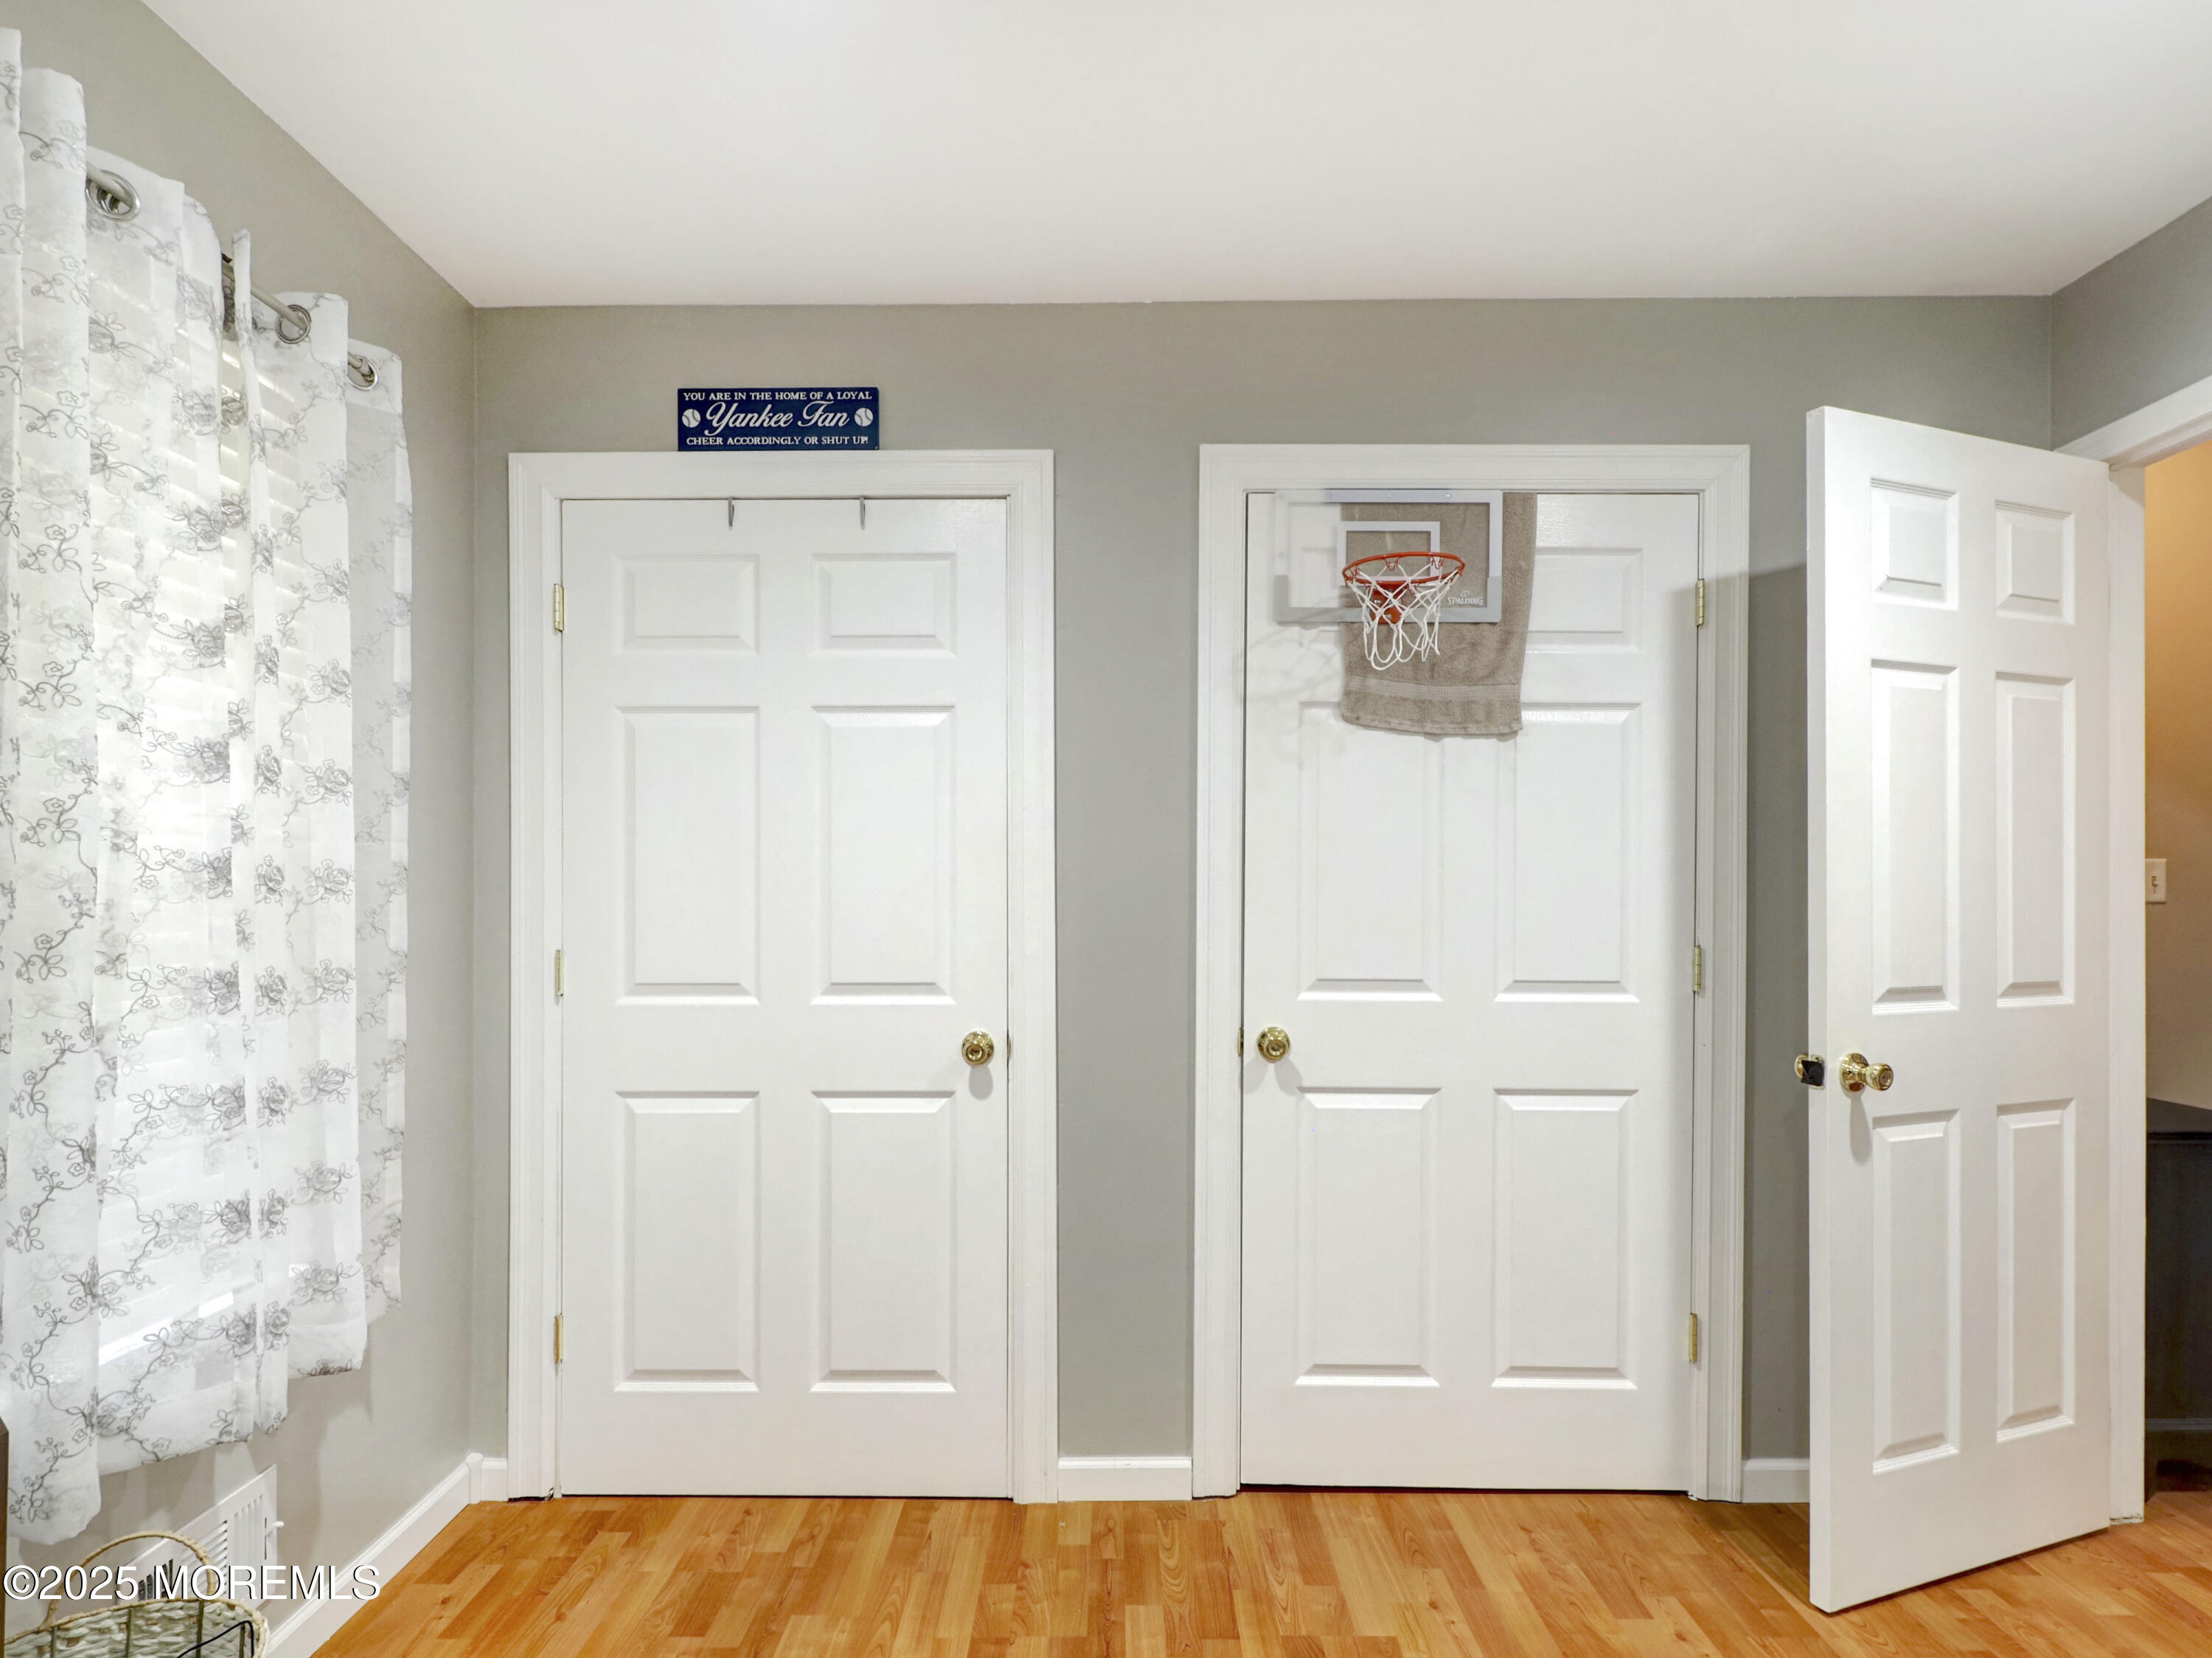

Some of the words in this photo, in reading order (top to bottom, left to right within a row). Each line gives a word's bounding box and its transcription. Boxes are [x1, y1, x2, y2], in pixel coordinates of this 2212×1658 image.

[684, 392, 706, 400] YOU
[709, 392, 731, 400] ARE
[775, 392, 807, 400] HOME
[810, 392, 824, 400] OF
[826, 392, 833, 400] A
[837, 391, 872, 400] LOYAL
[704, 401, 793, 436] Yankee
[797, 400, 849, 427] Fan
[686, 437, 723, 445] CHEER
[727, 437, 801, 445] ACCORDINGLY
[804, 437, 818, 445] OR
[821, 437, 849, 445] SHUT
[1447, 596, 1484, 606] SPALDING
